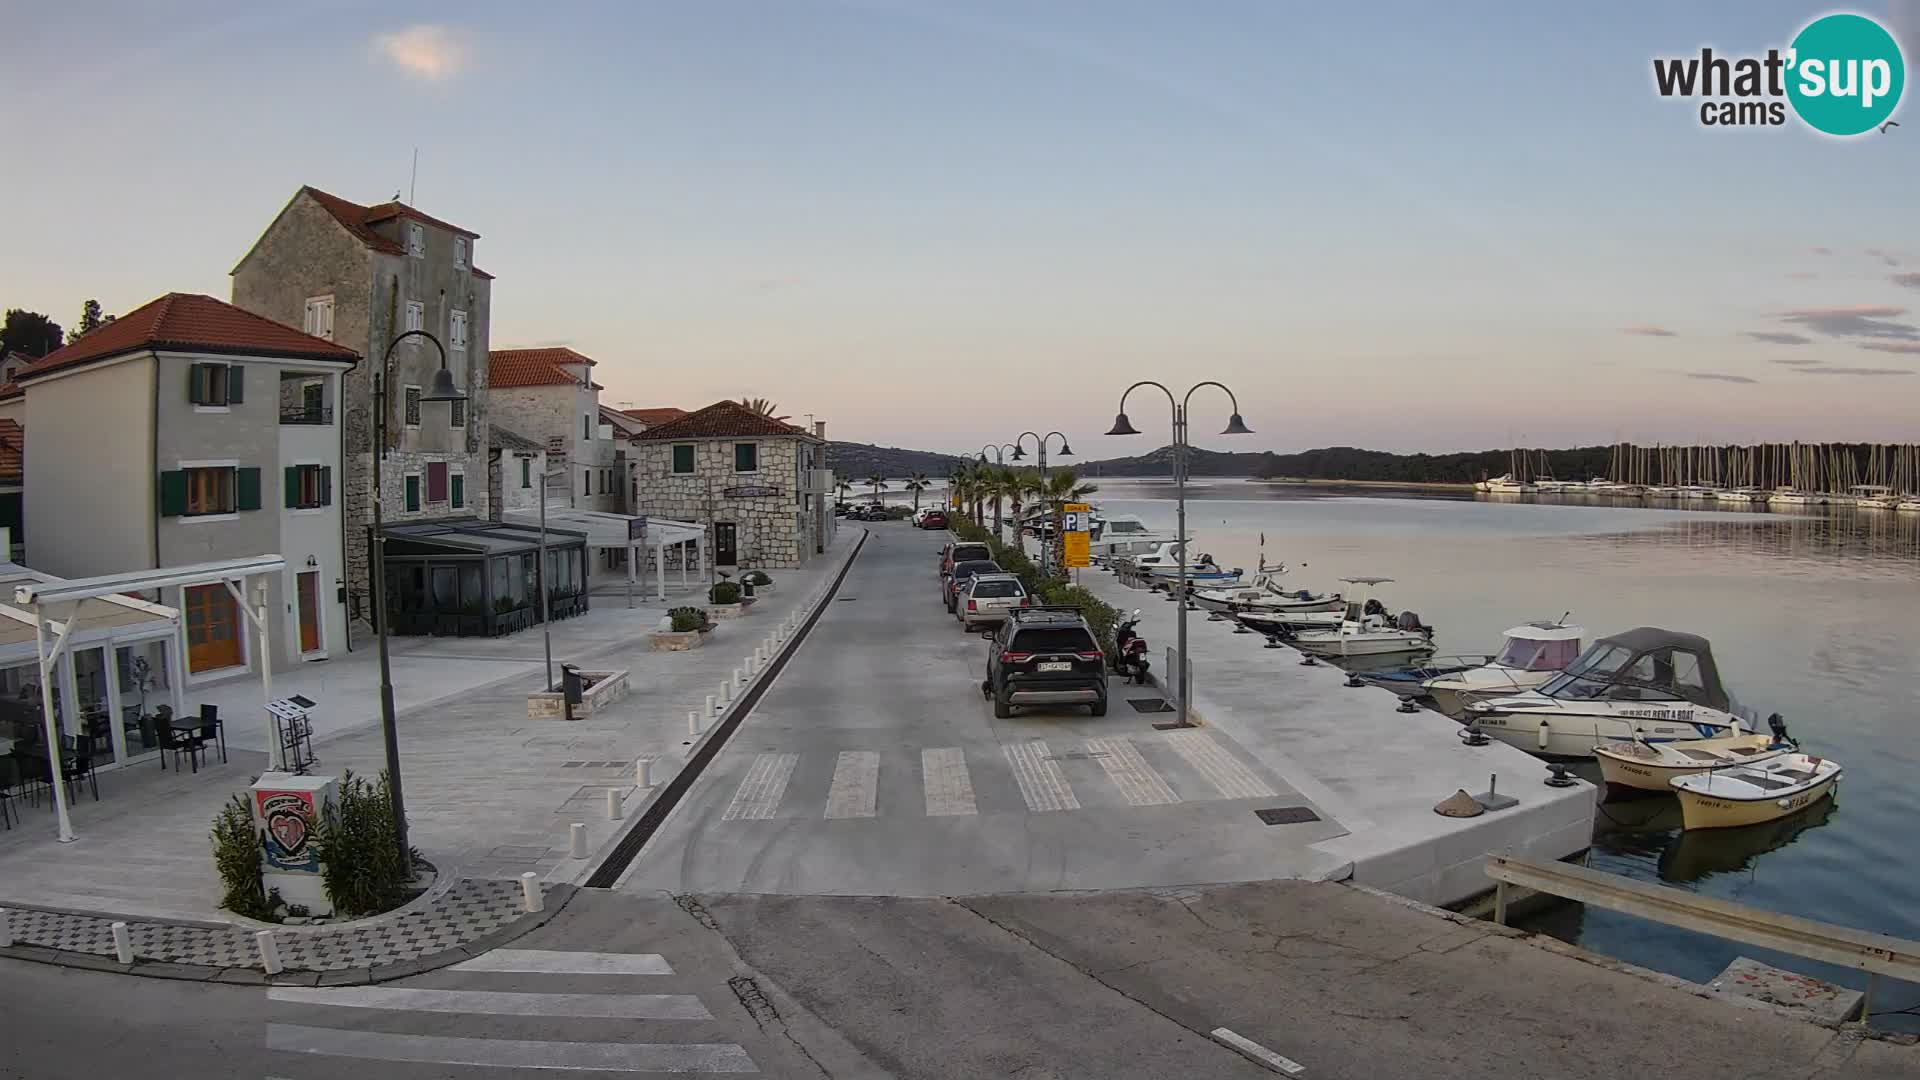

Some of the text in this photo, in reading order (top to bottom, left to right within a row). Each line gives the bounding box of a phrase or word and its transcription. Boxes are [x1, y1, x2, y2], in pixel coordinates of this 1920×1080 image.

[1066, 514, 1077, 530] P
[1652, 709, 1671, 719] RENT
[1671, 710, 1676, 720] A
[1677, 710, 1695, 721] BOAT
